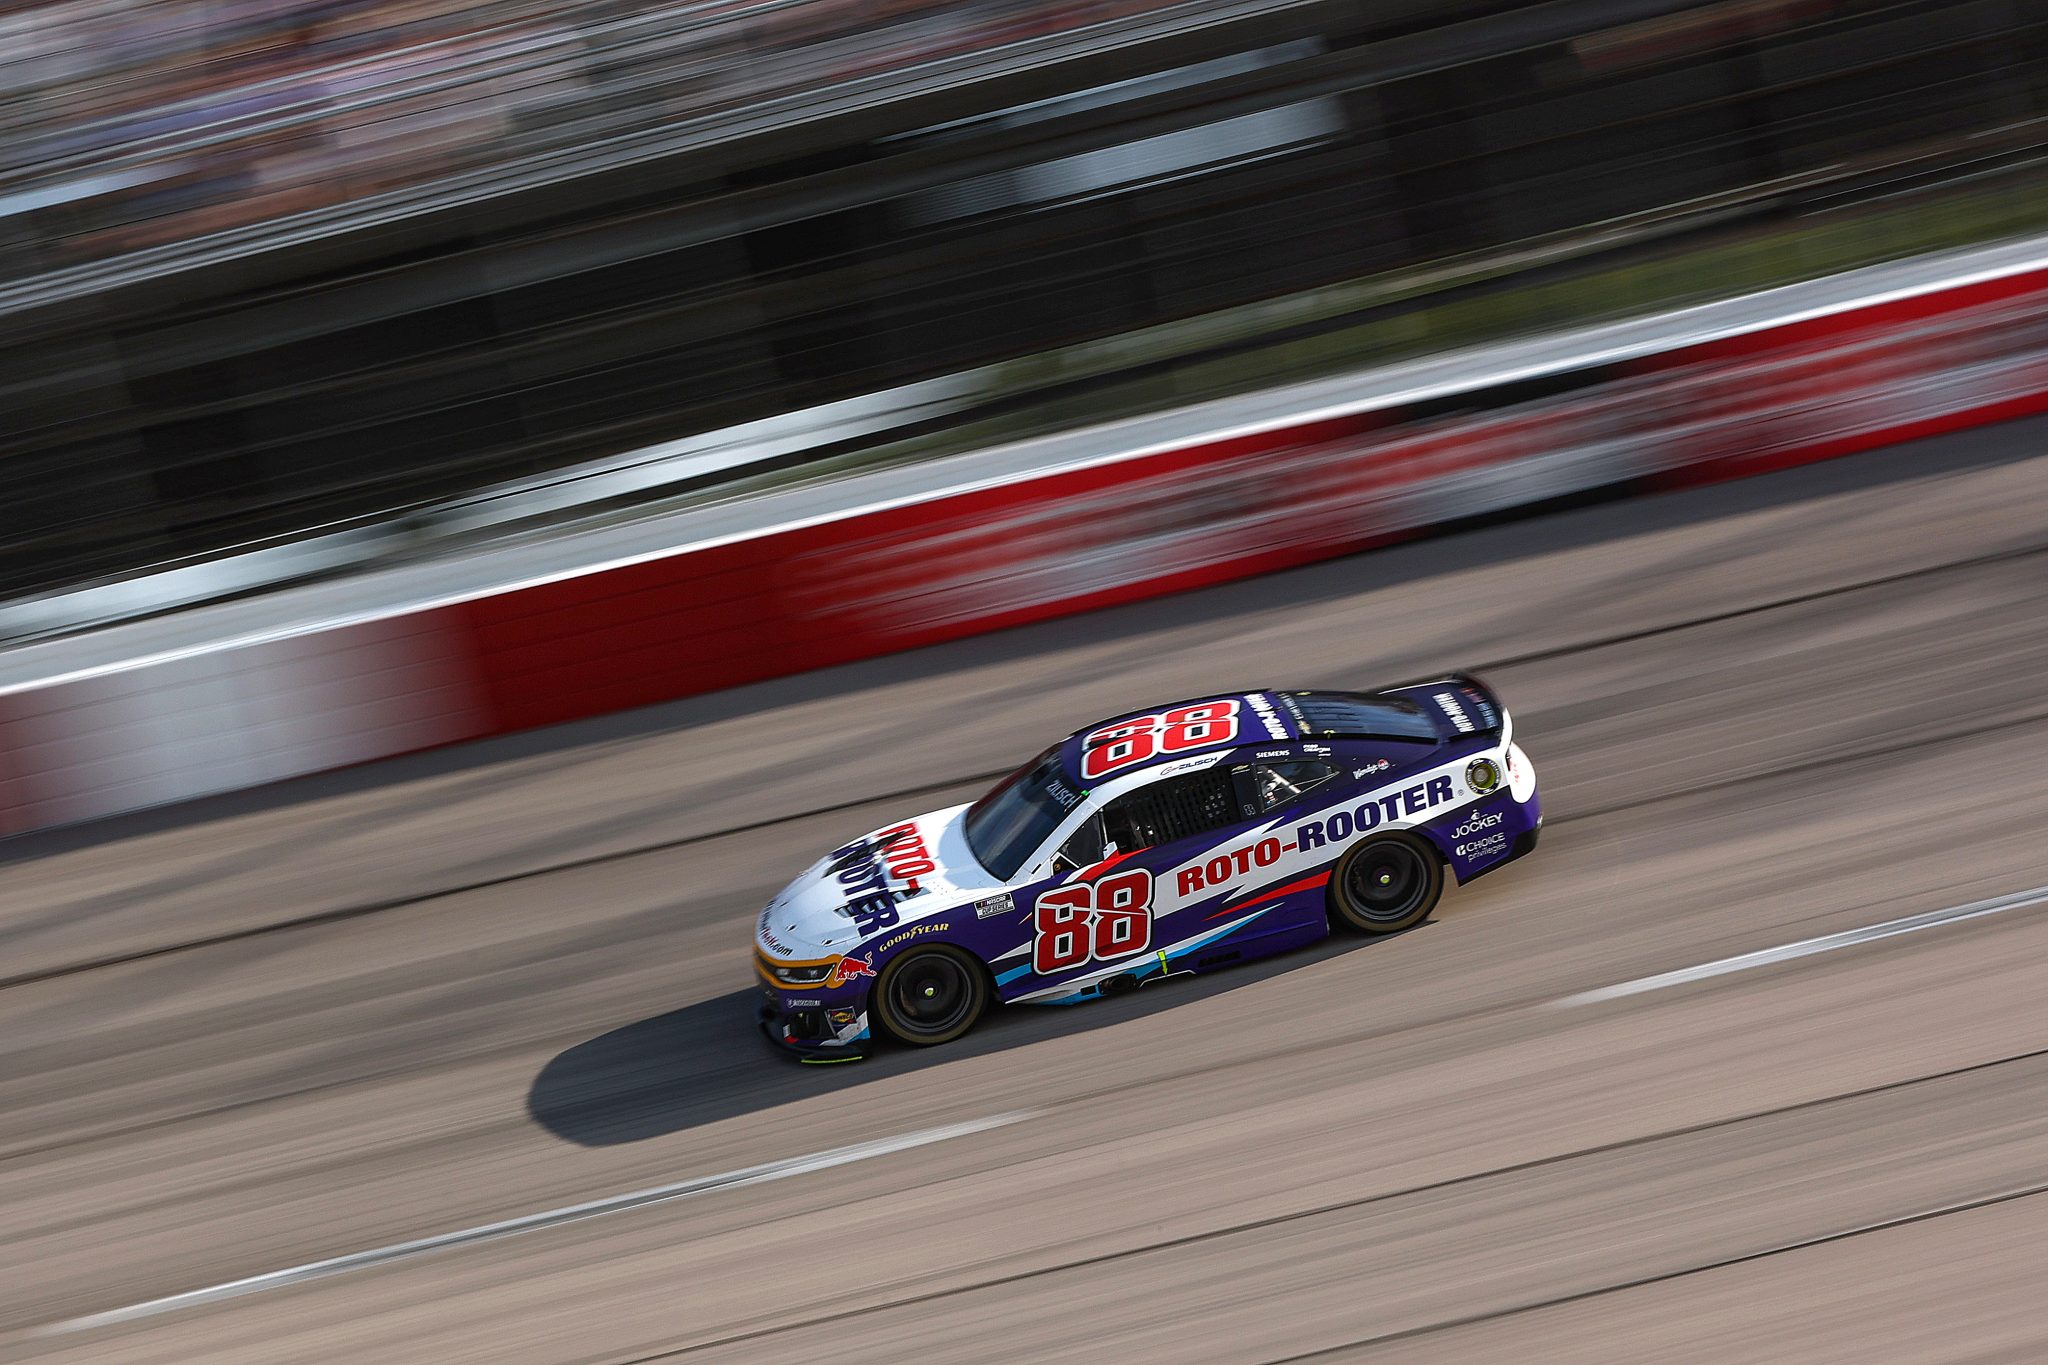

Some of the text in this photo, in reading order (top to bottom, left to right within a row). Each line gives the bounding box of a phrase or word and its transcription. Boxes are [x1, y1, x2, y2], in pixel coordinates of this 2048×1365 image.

[1080, 698, 1242, 781] 88
[1178, 756, 1218, 771] ZILISCH
[1255, 750, 1290, 759] SIEMENS
[1045, 779, 1077, 811] ZILISCH
[1176, 774, 1454, 898] ROTO-ROOTER
[1450, 812, 1503, 839] JOCKEY
[1465, 832, 1506, 852] CHOICE
[1467, 842, 1508, 863] privileges
[1034, 868, 1153, 976] 88
[879, 922, 949, 953] GOODYEAR
